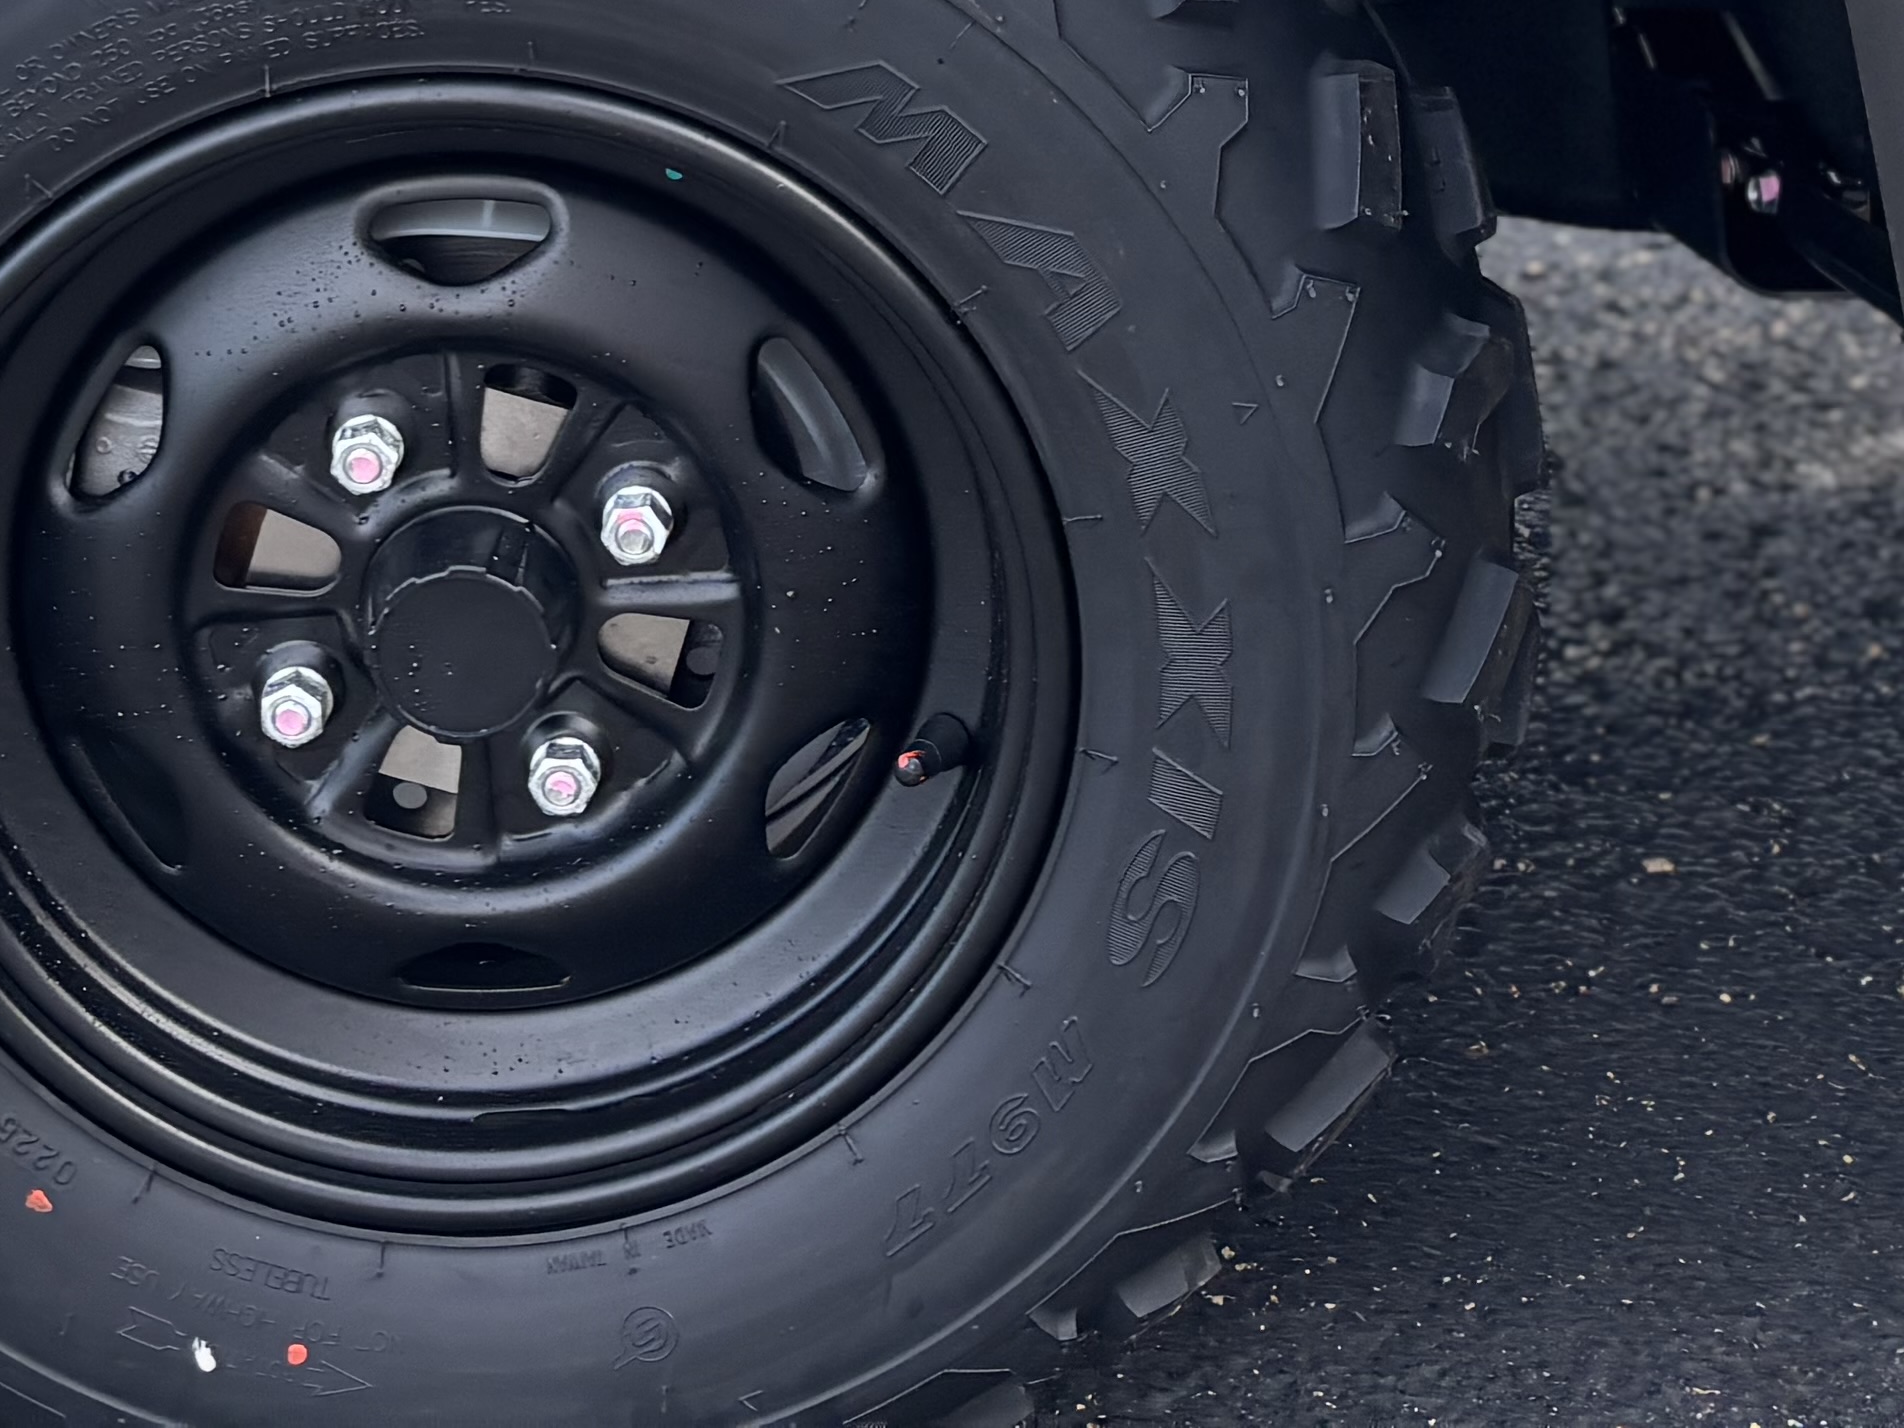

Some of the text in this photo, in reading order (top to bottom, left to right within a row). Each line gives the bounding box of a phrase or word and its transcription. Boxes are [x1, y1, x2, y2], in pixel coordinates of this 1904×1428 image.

[13, 54, 45, 80] OR
[776, 58, 1236, 990] MAXXIS
[881, 1016, 1096, 1258] M977
